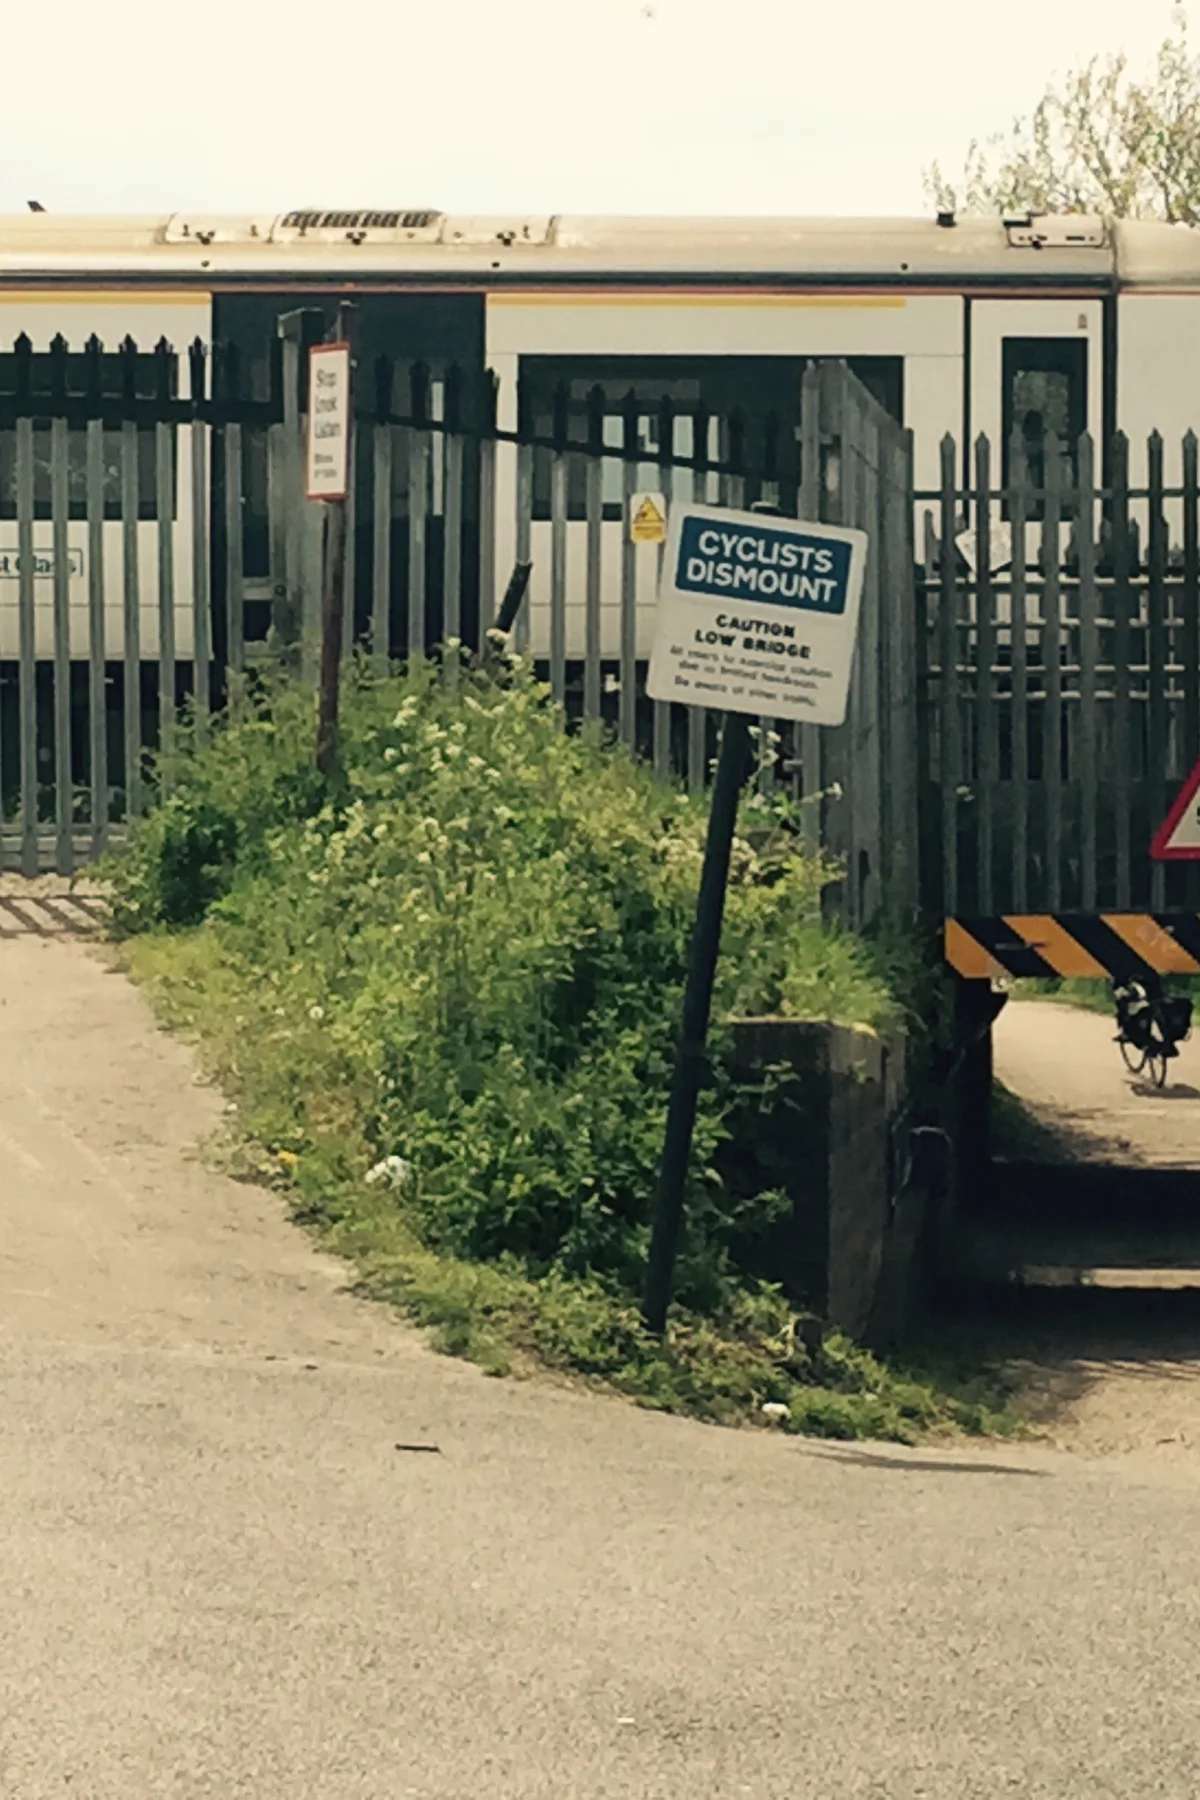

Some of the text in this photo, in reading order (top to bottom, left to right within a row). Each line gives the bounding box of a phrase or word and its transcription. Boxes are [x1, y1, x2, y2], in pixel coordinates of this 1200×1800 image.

[698, 530, 834, 574] CYCLISTS
[686, 557, 838, 603] DISMOUNT
[694, 629, 812, 660] LOW BRIDGE
[715, 613, 796, 639] CAUTION
